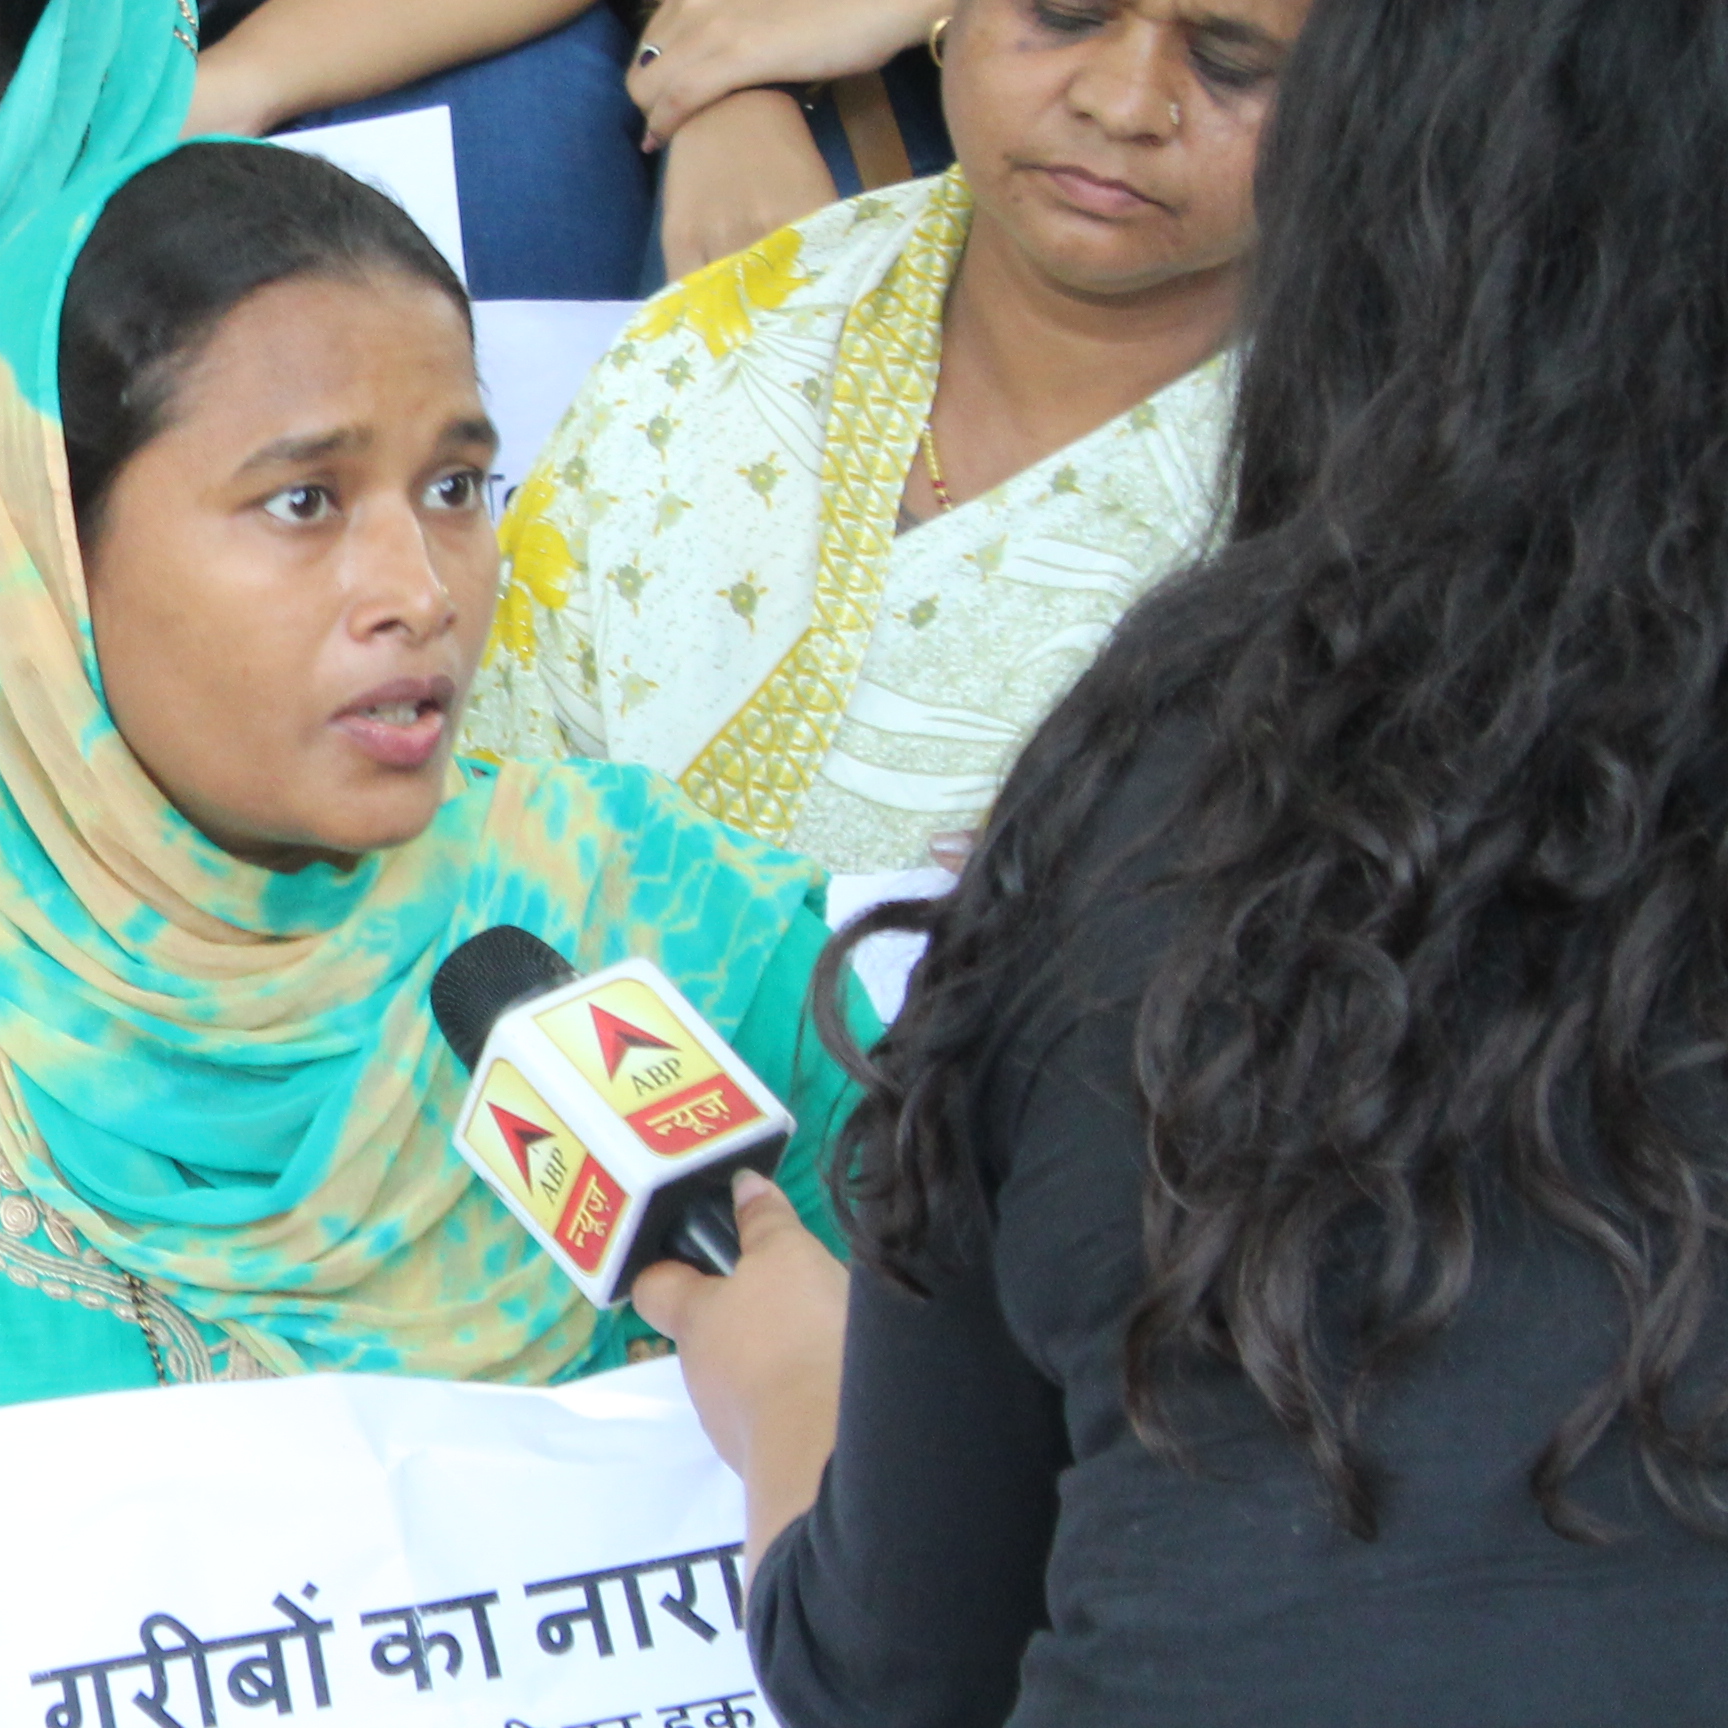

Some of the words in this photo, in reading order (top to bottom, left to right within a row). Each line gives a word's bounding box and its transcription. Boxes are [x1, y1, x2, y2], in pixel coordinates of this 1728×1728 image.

[629, 1056, 684, 1099] ABP
[537, 1144, 567, 1206] ABP
[30, 1581, 336, 1728] गरीबों
[361, 1590, 501, 1693] का
[523, 1539, 745, 1658] नारा
